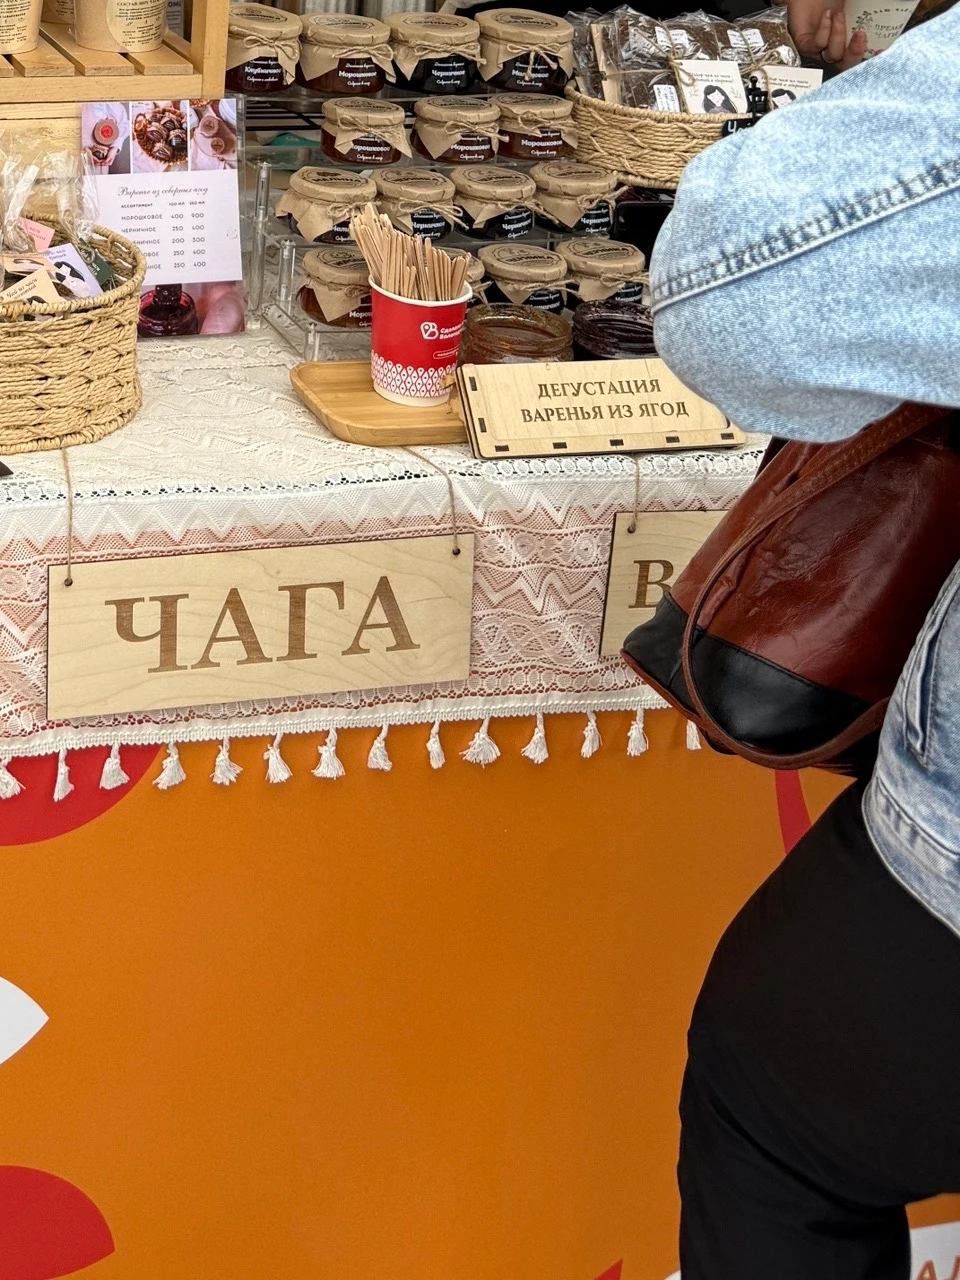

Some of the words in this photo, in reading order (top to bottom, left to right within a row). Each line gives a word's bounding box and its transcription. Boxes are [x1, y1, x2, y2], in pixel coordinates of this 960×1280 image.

[338, 70, 377, 79] Морошковое
[352, 144, 390, 153] орошковое
[521, 139, 564, 149] Морошковое
[537, 378, 662, 401] ДЕГУСТАЦИЯ
[521, 404, 604, 423] ВАРЕНЬЯ
[607, 404, 634, 420] ИЗ
[638, 401, 690, 420] ЯГОД
[628, 559, 674, 609] В
[104, 575, 421, 675] ЧАГА
